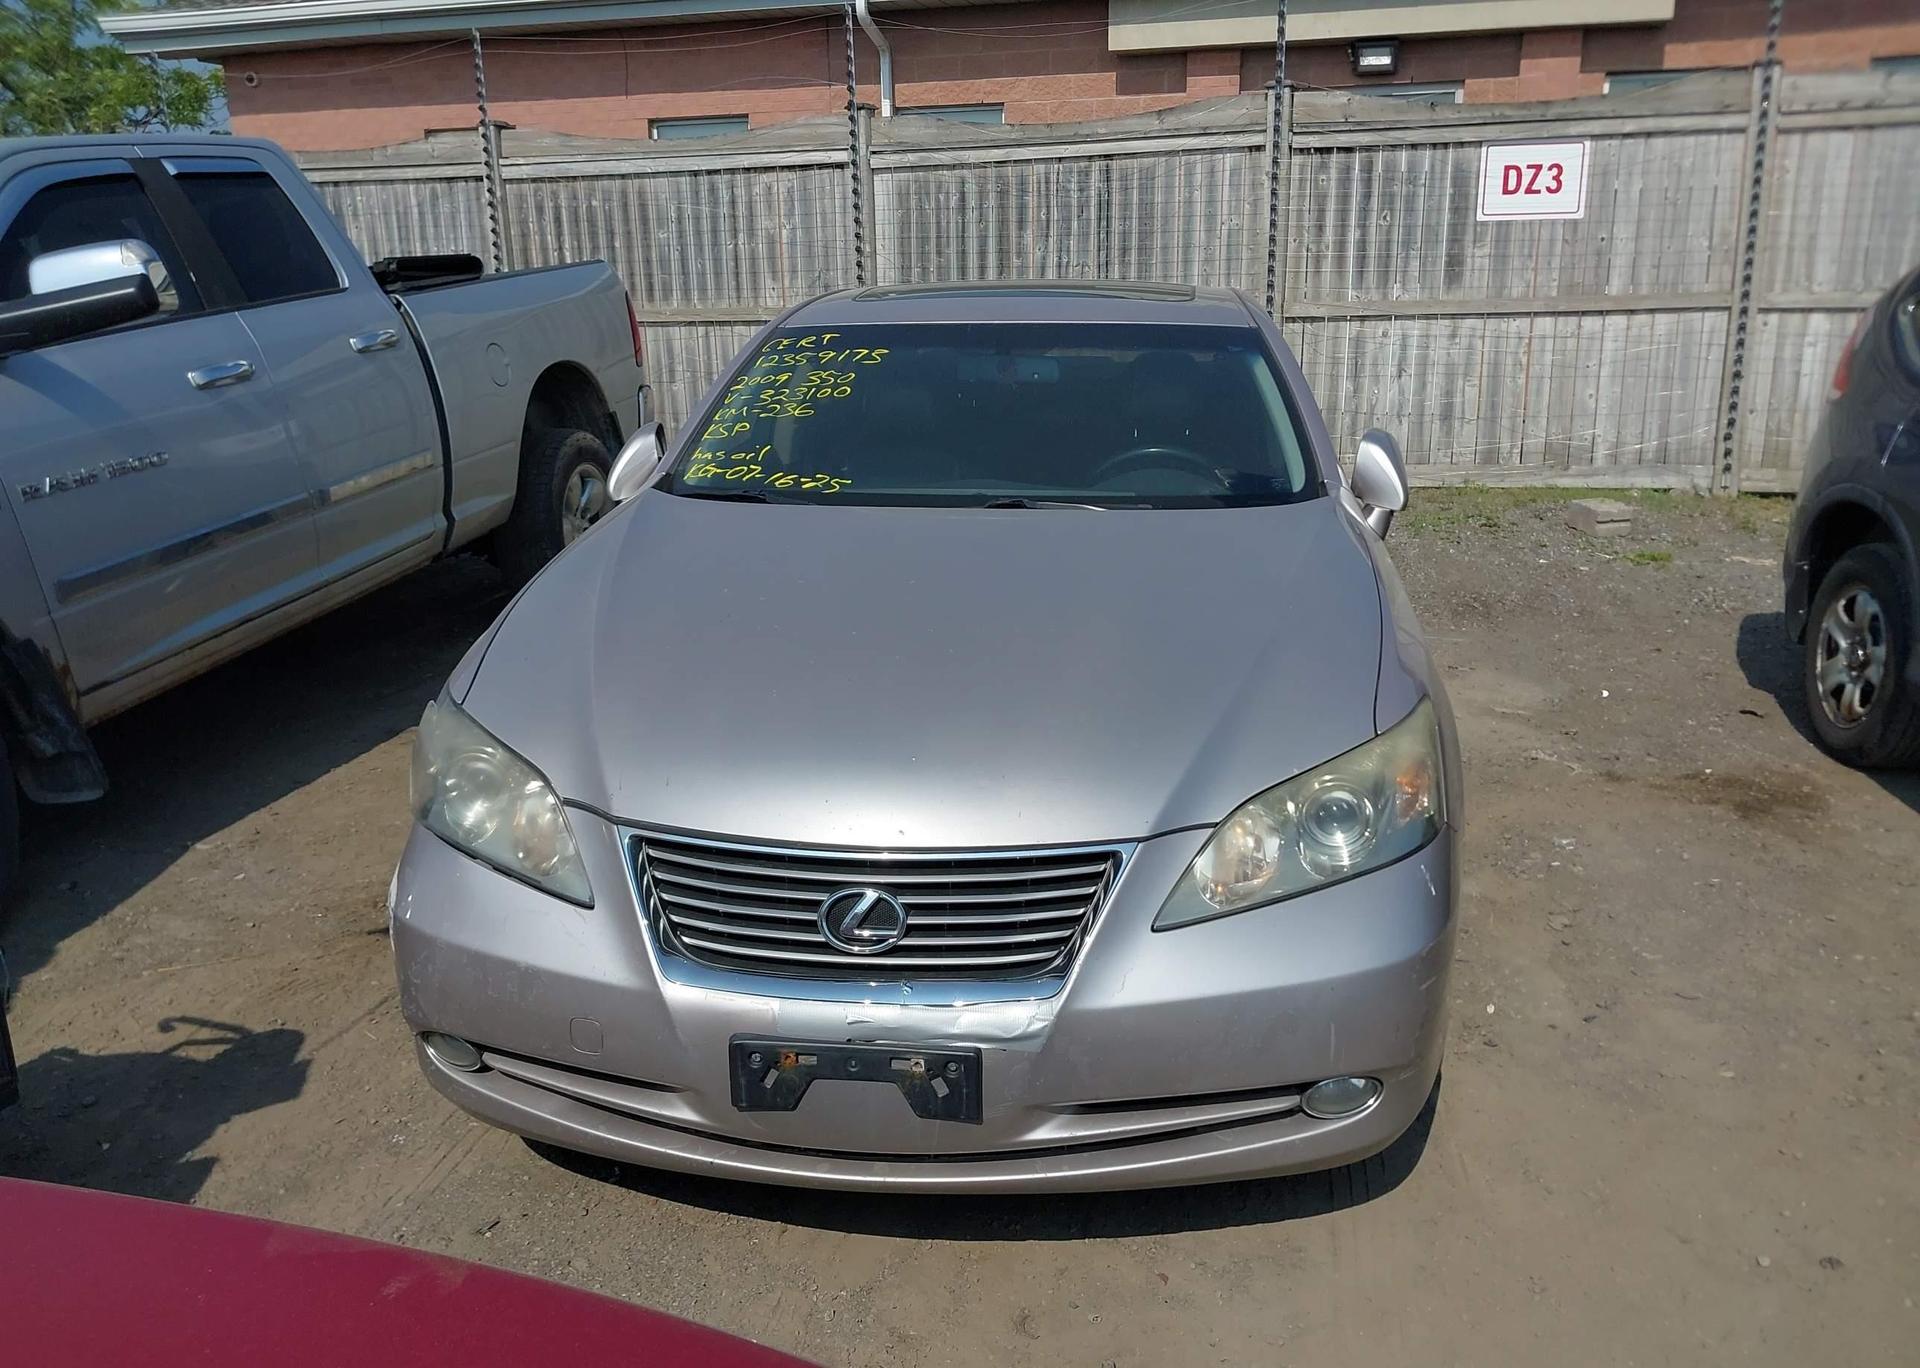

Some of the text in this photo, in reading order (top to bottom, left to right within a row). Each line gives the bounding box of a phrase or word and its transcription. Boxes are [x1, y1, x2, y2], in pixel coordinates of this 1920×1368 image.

[1502, 162, 1564, 194] DZ3
[762, 334, 841, 352] CERT
[731, 370, 856, 391] 2009 350
